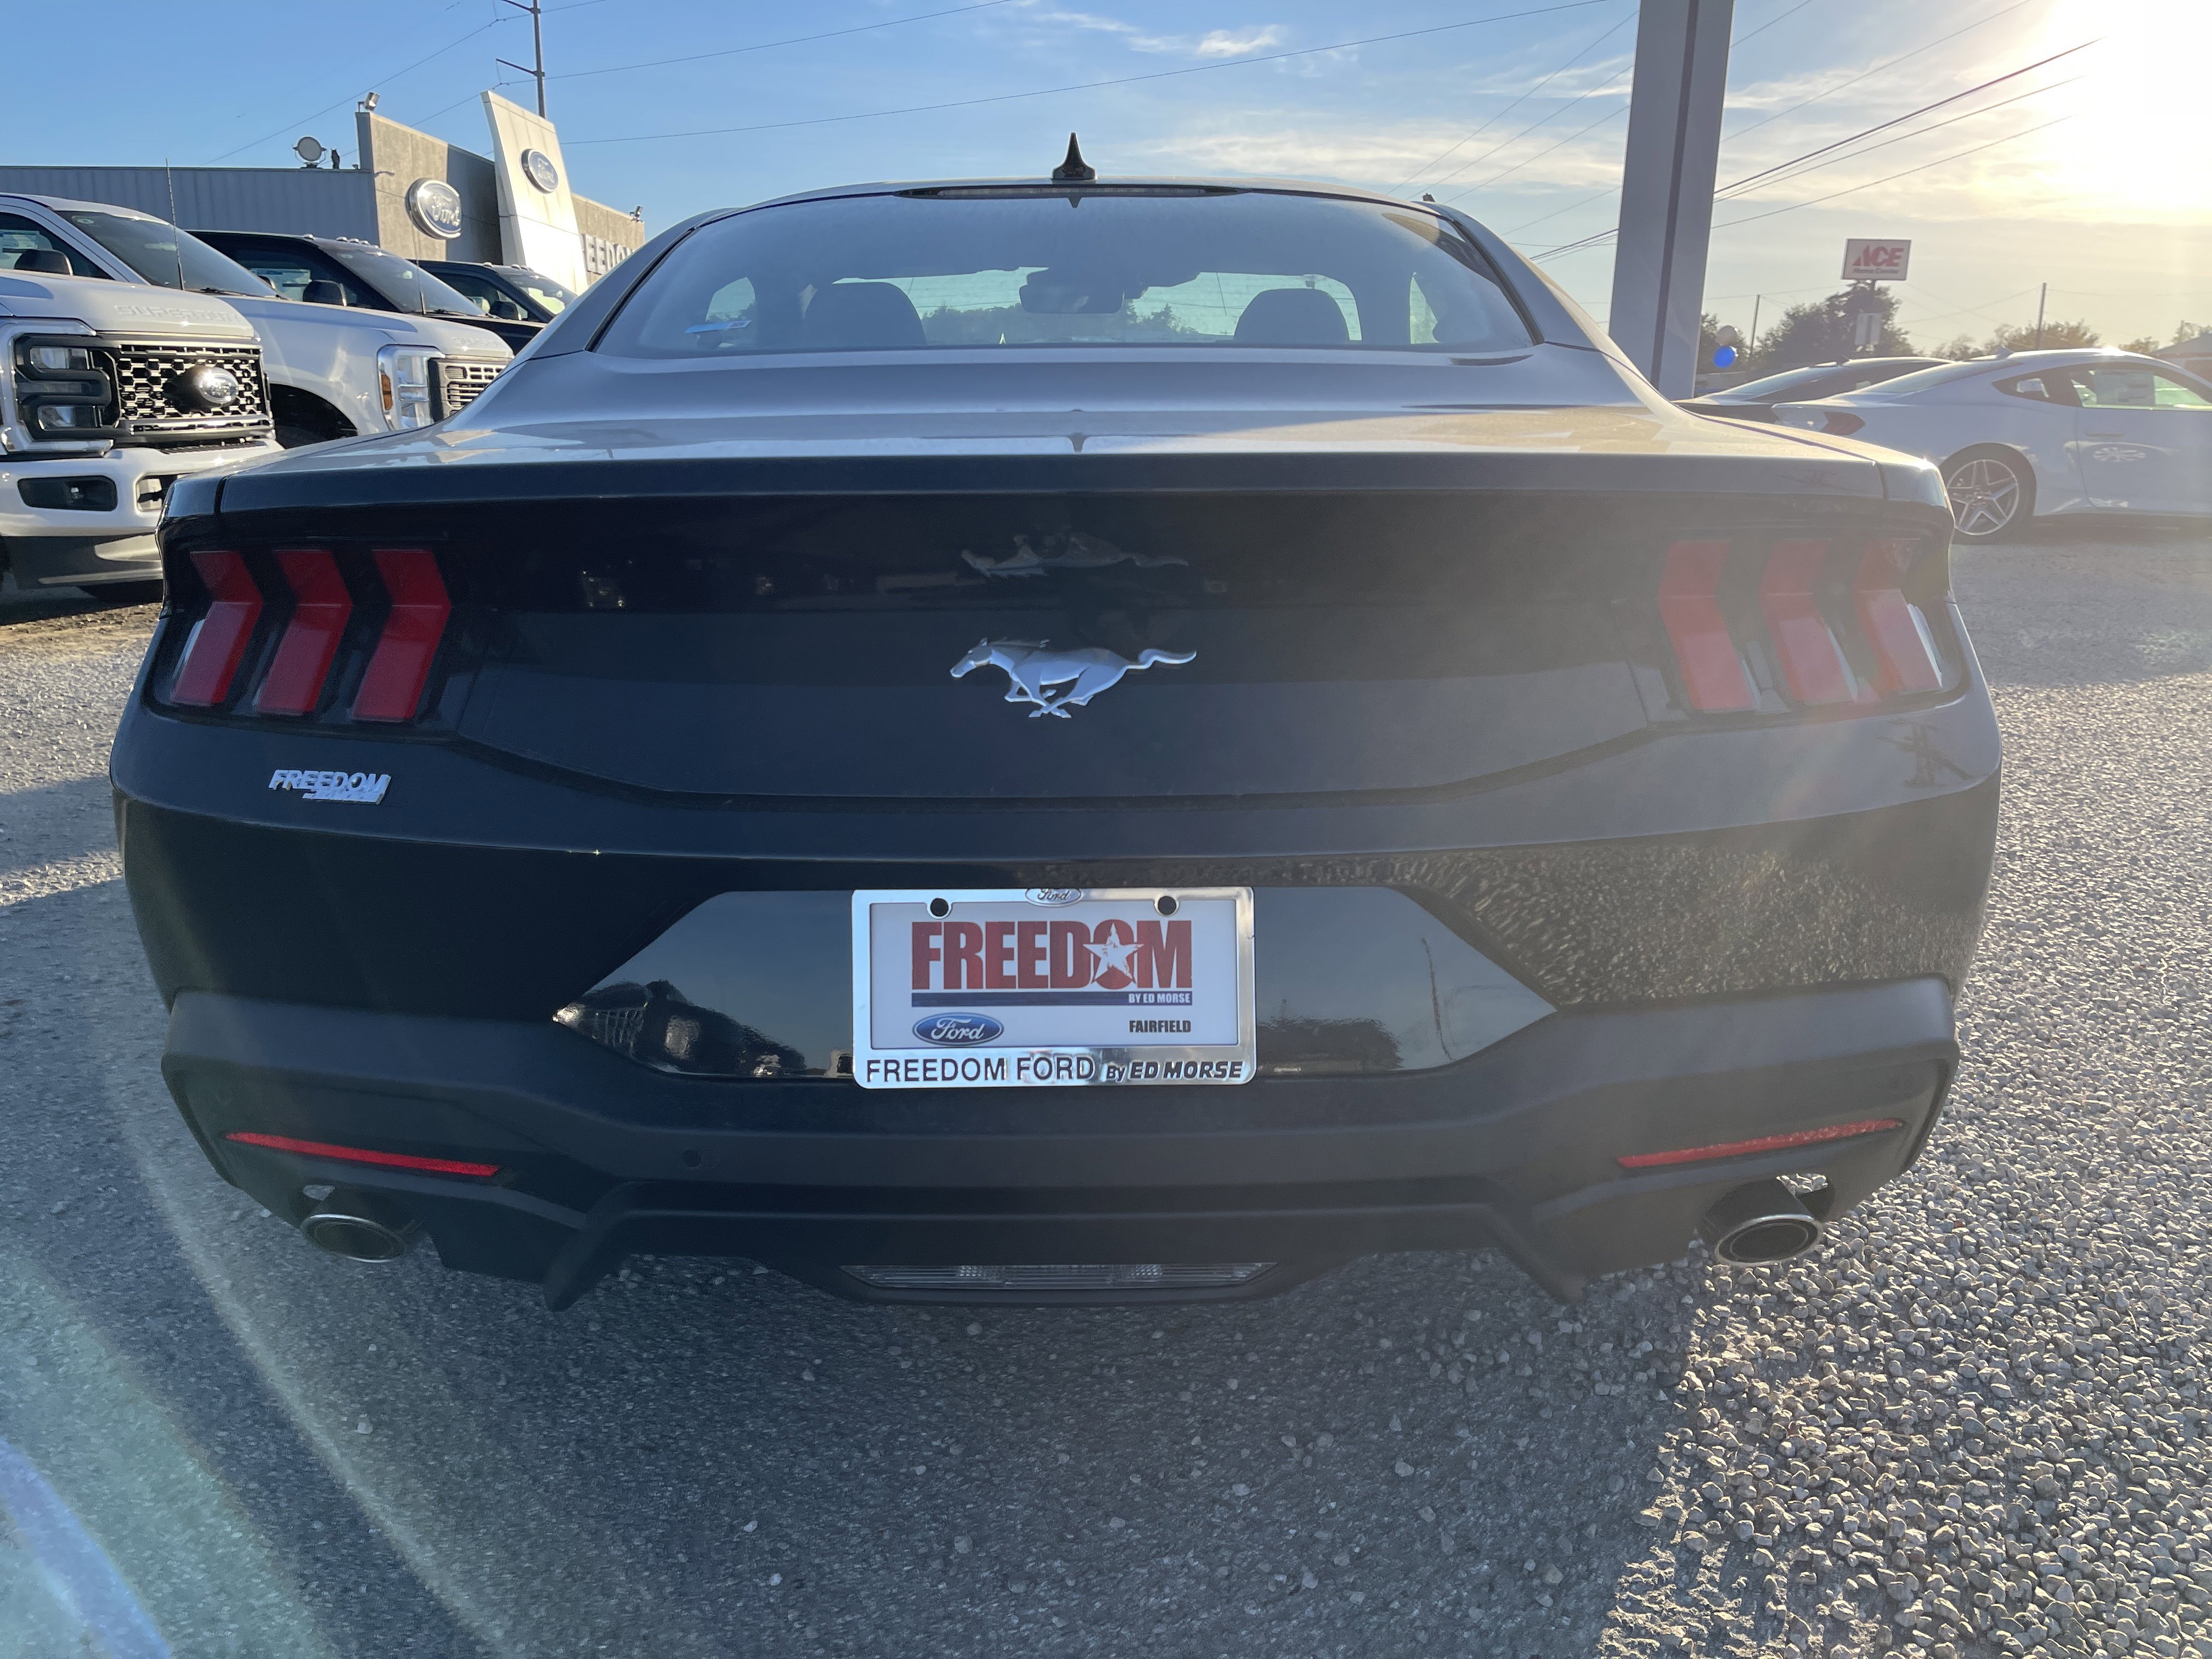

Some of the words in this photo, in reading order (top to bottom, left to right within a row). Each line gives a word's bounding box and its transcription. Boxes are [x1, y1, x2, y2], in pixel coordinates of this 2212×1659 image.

[431, 194, 461, 227] Ford
[580, 234, 636, 274] EEDO
[1852, 245, 1904, 267] ACE
[269, 769, 391, 792] FREEDOM
[1037, 888, 1070, 900] Ford
[912, 919, 1192, 990] FREEDOM
[1128, 992, 1141, 1003] BY
[1143, 992, 1155, 1003] ED
[1156, 992, 1190, 1003] MORSE
[930, 1017, 986, 1040] Ford
[1129, 1020, 1191, 1032] FAIRFIELD
[867, 1057, 1006, 1082] FREEDOM
[1017, 1056, 1094, 1080] FORD
[1106, 1065, 1126, 1082] By
[1128, 1061, 1159, 1079] ED
[1163, 1061, 1244, 1079] MORSE
